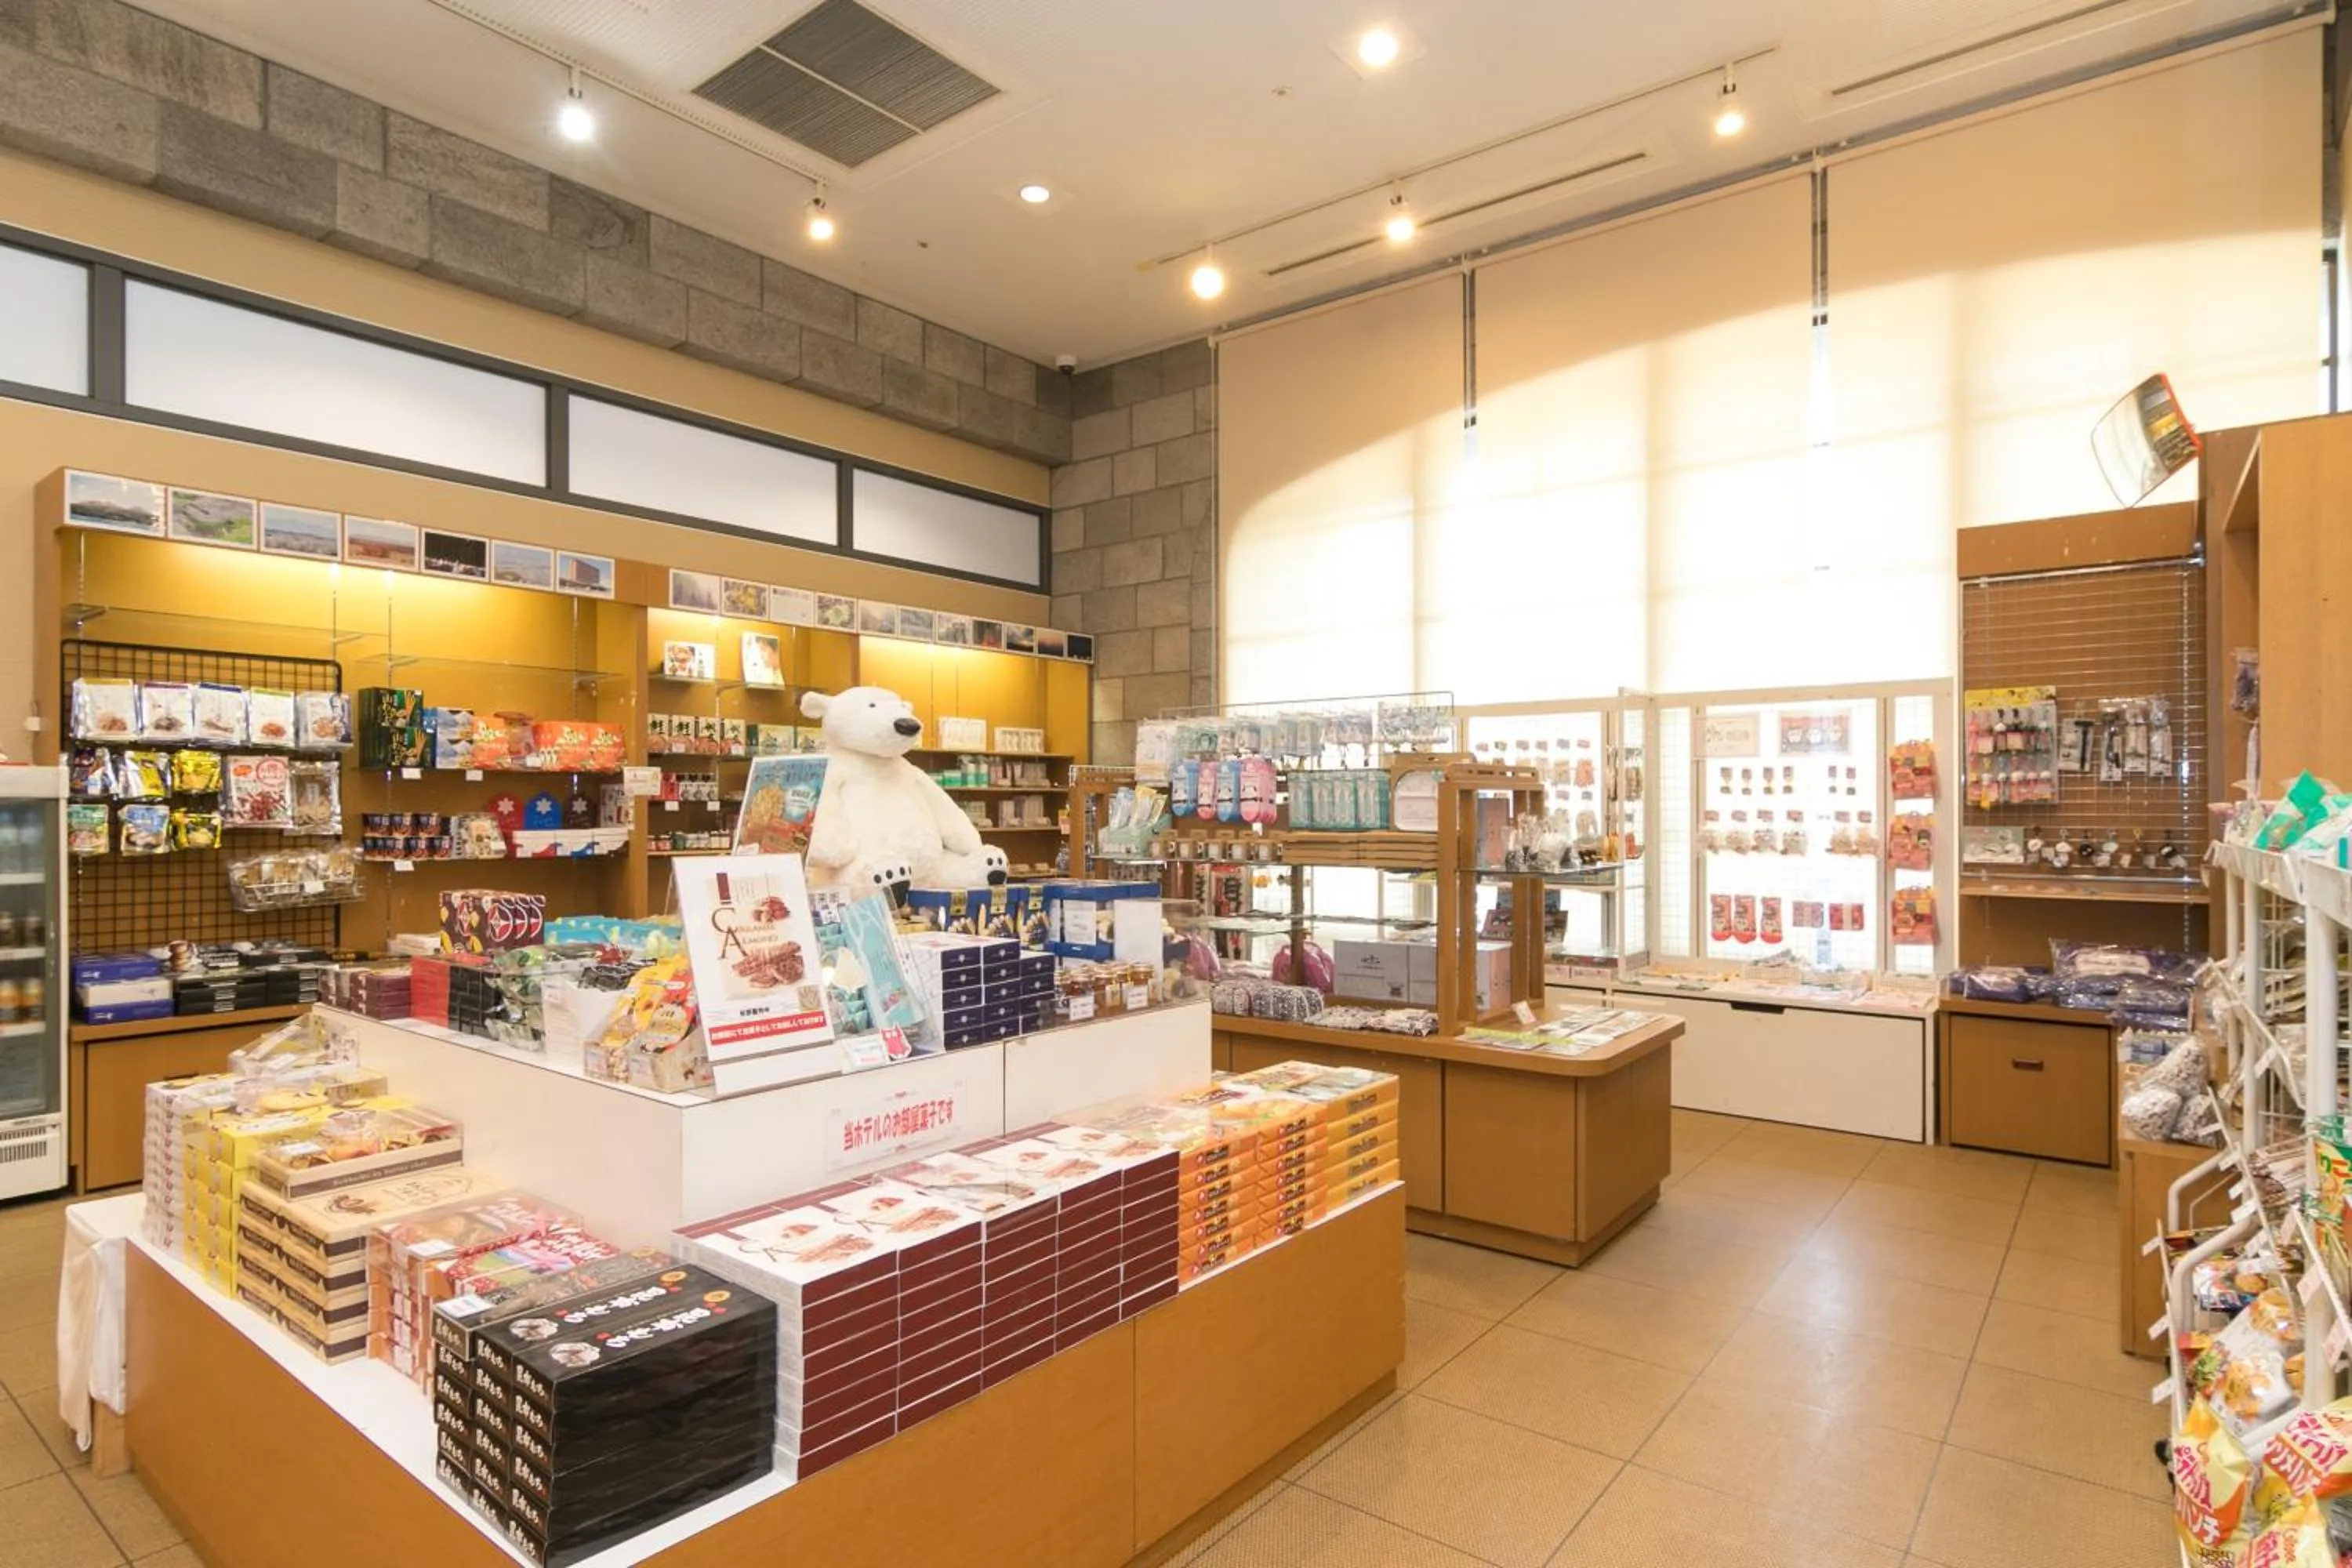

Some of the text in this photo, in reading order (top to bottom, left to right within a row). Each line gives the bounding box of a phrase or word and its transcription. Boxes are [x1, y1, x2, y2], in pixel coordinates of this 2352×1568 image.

[843, 1098, 954, 1151] 当ホテルのお部屋菓子です
